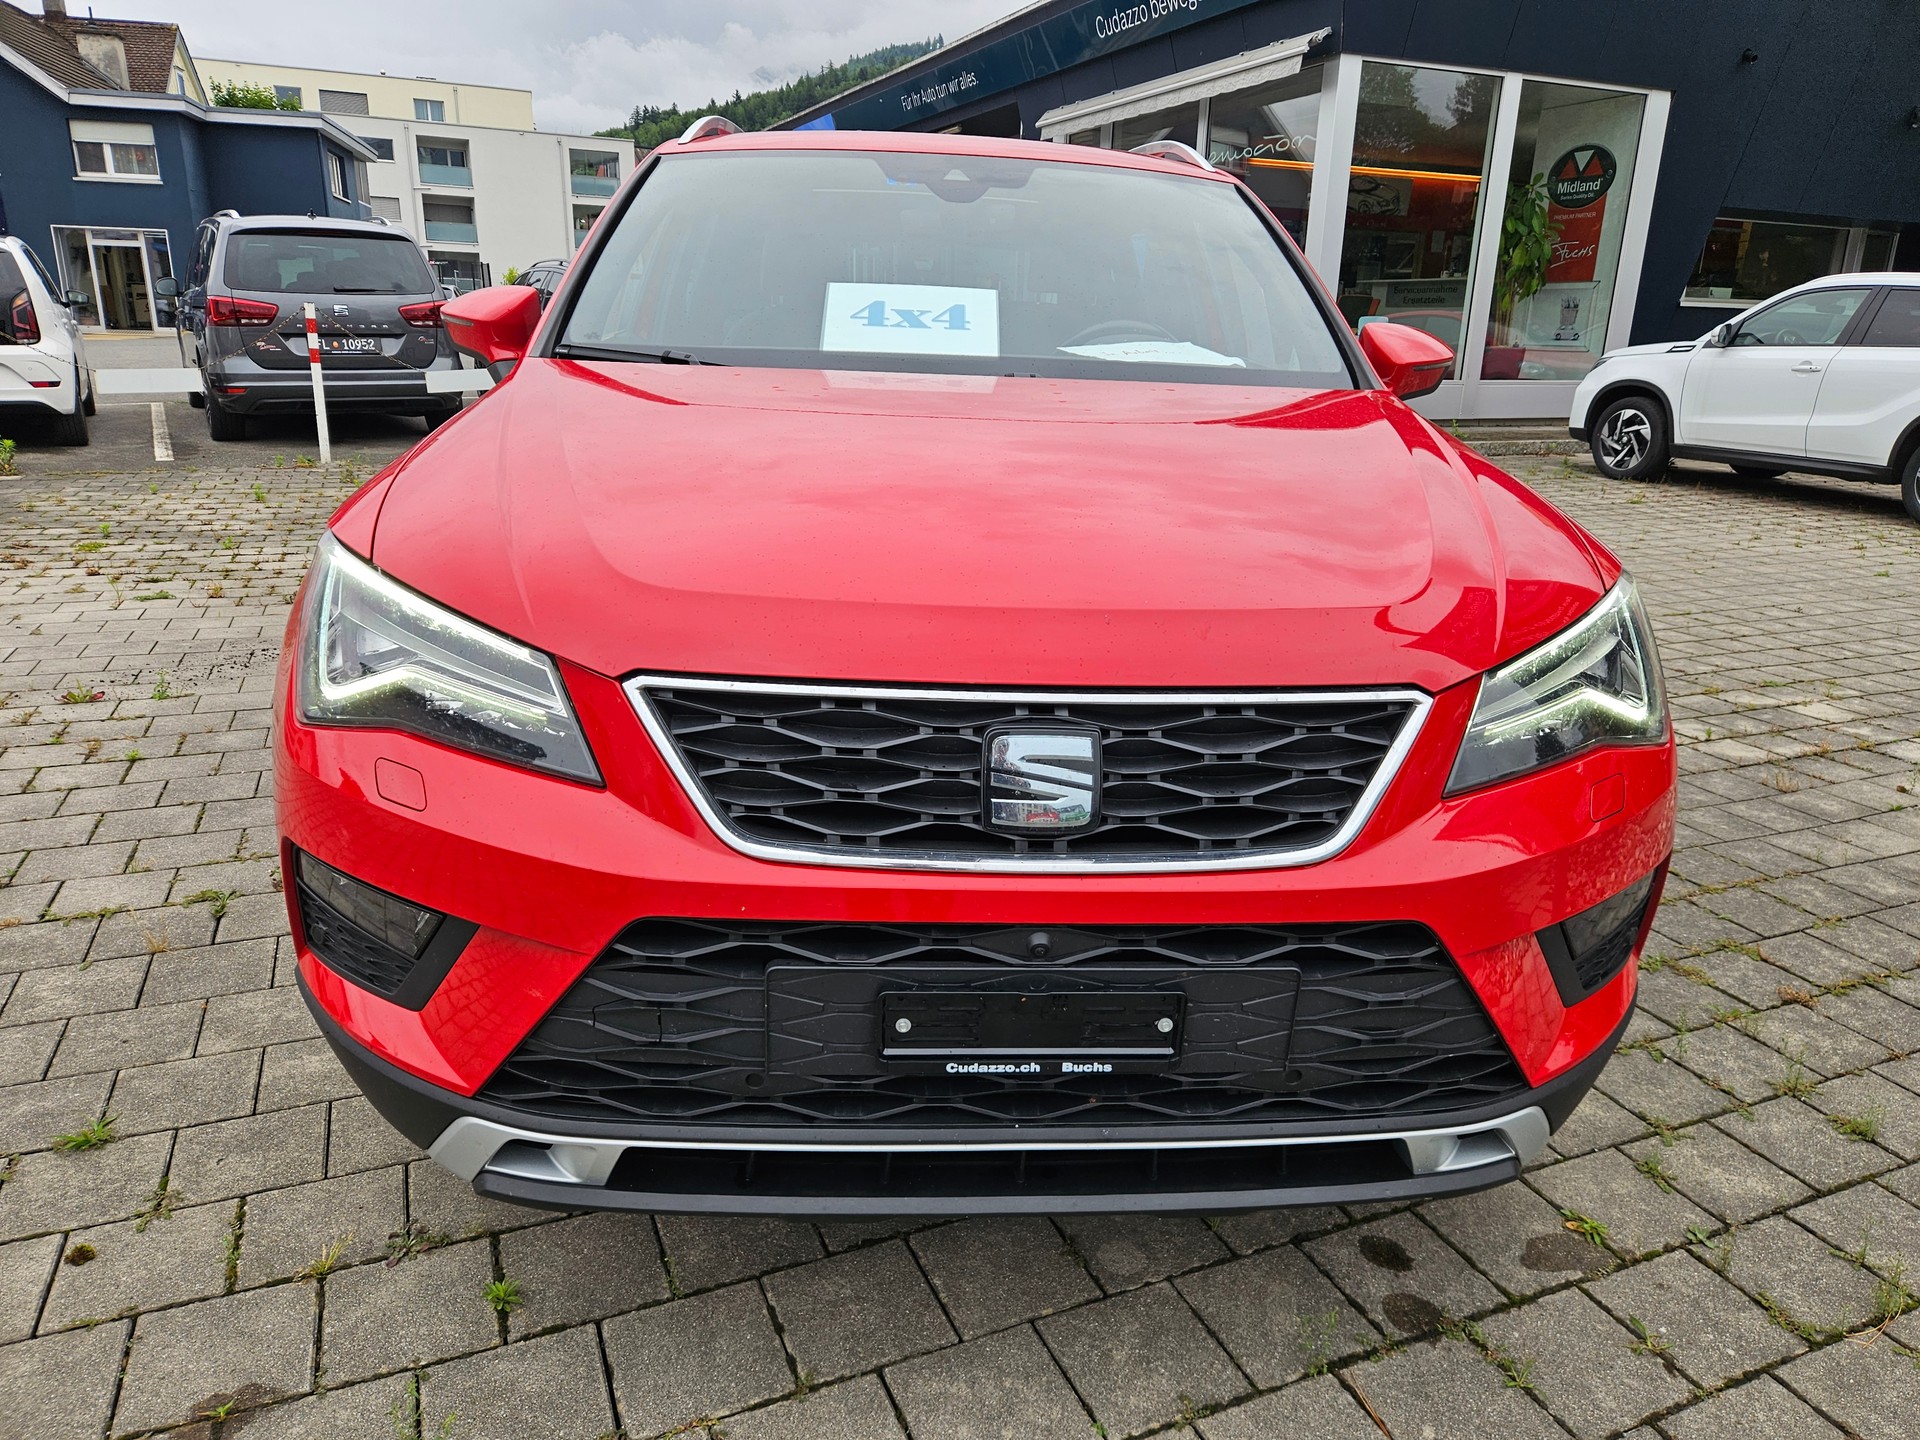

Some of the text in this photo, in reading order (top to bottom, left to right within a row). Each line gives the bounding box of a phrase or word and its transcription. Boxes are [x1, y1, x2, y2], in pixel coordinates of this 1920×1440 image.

[1095, 4, 1148, 38] Cudazzo
[901, 71, 979, 111] Für Ihr Auto tun wir alles.
[1557, 180, 1600, 194] Midland
[1575, 211, 1597, 219] PARTNER
[1393, 284, 1458, 294] Serviceannahme
[1402, 296, 1446, 305] Ersatzteile
[850, 300, 971, 331] 4x4
[341, 338, 376, 350] 10952
[946, 1062, 1113, 1073] Cudazzo.ch Buchs
